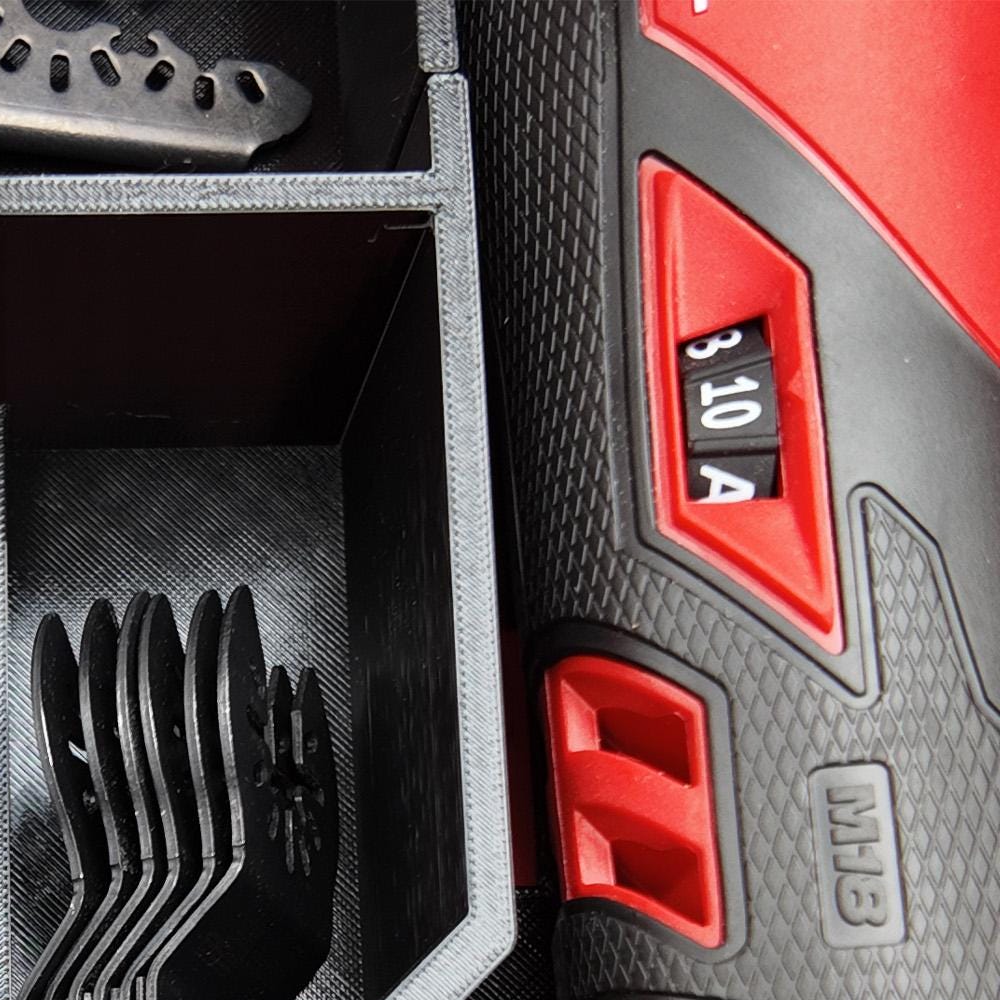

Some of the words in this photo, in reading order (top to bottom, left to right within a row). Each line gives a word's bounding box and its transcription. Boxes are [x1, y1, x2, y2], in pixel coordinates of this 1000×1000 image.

[685, 328, 743, 360] 8
[700, 376, 762, 429] 10
[696, 464, 756, 504] A
[826, 783, 890, 927] M18
